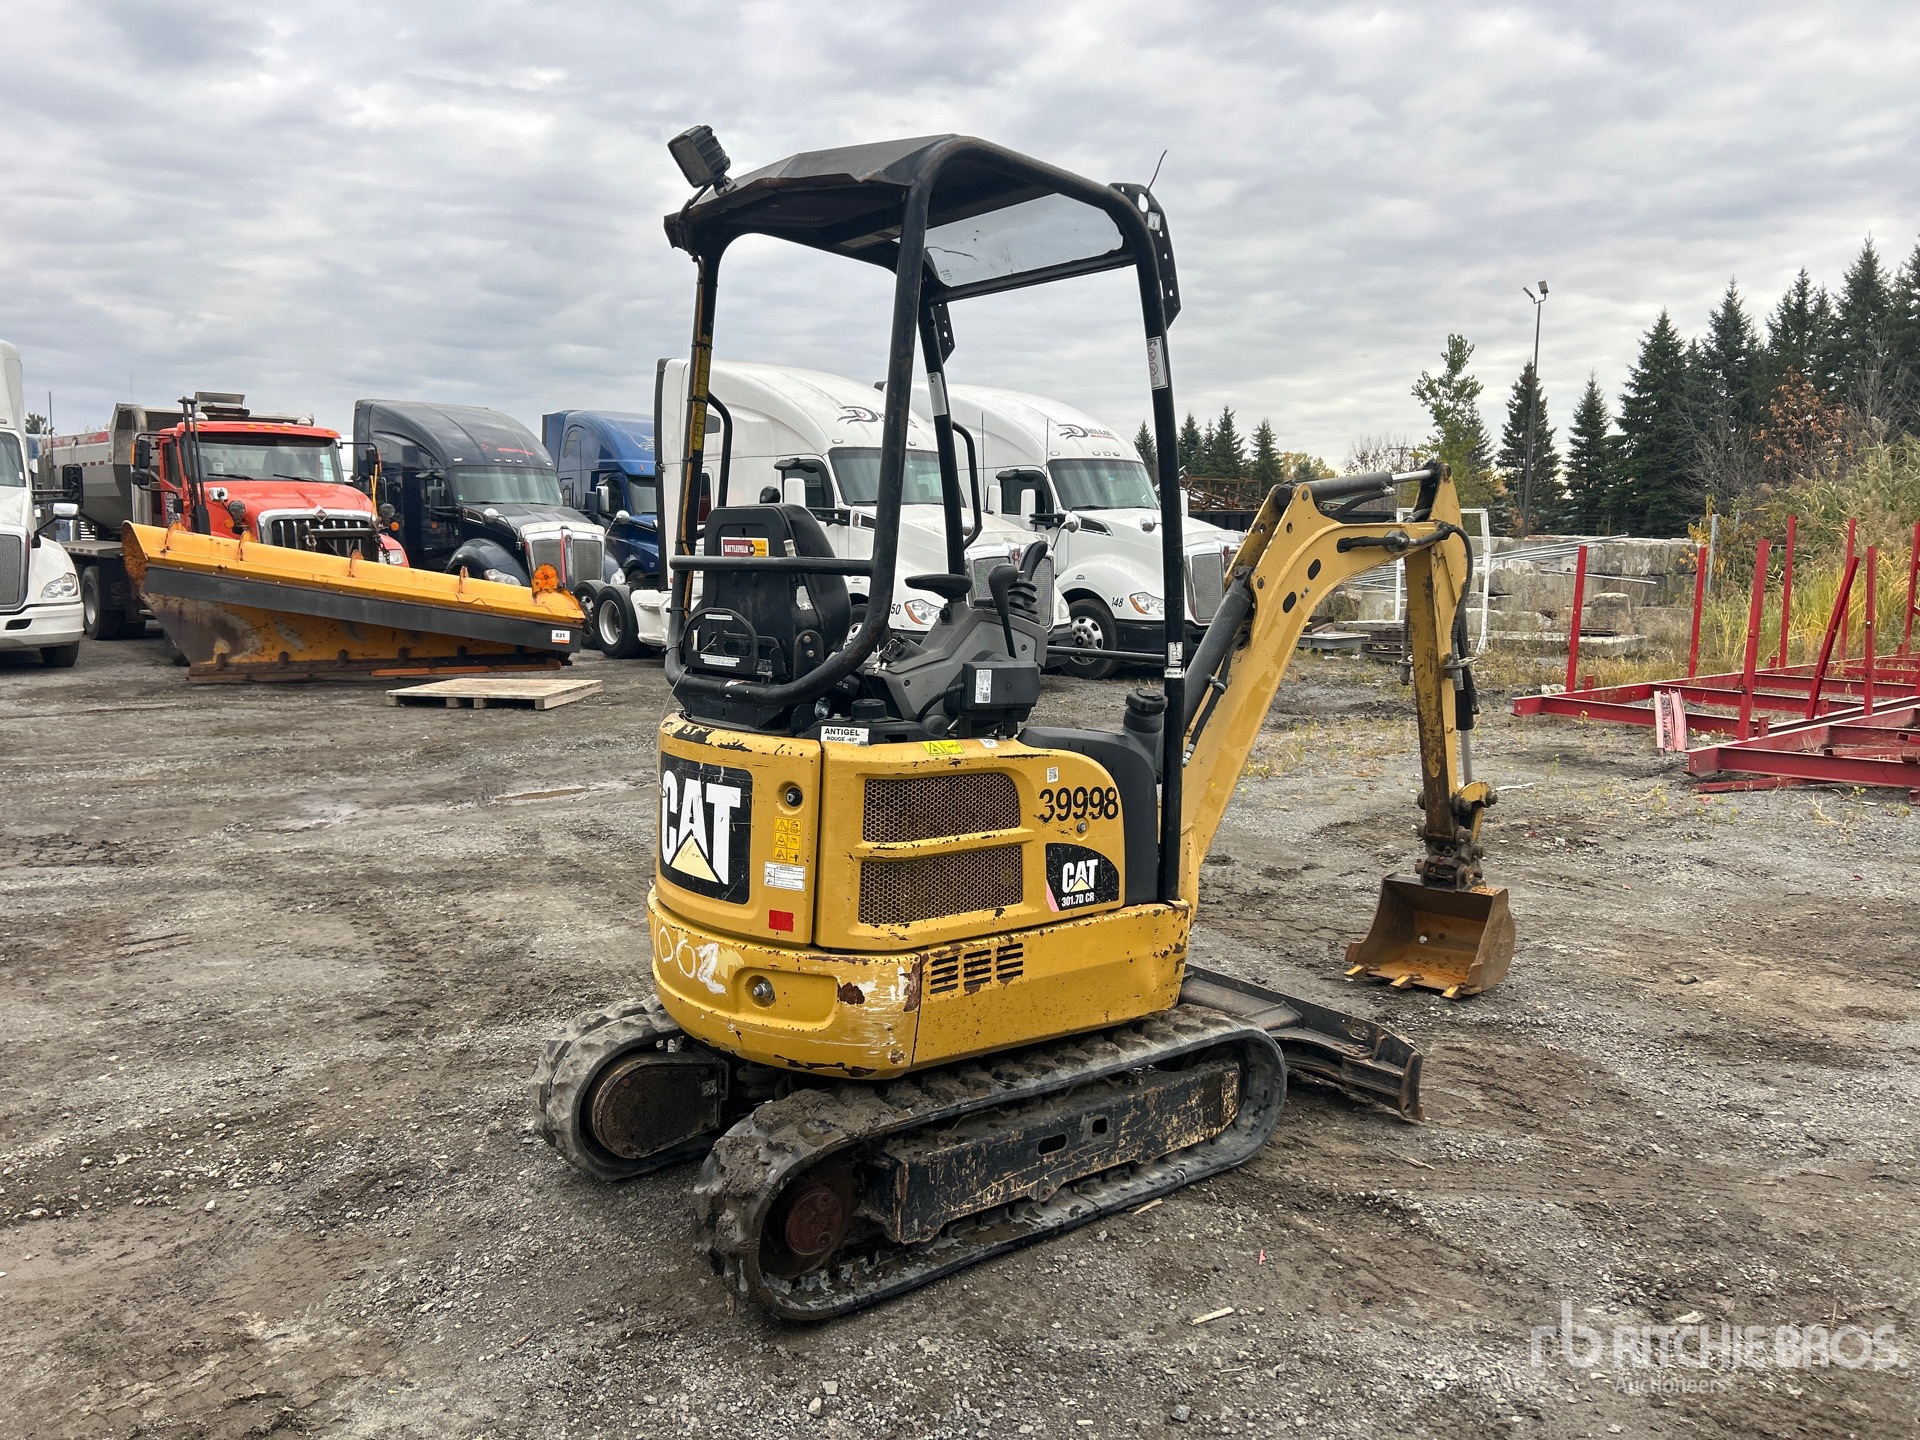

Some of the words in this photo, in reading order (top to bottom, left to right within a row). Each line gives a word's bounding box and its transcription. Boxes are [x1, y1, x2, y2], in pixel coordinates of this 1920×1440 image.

[1111, 597, 1124, 607] 148
[824, 727, 860, 737] ANTIGEL
[1038, 786, 1119, 823] 39998
[662, 769, 742, 886] CAT
[1062, 858, 1099, 894] CAT
[1061, 893, 1084, 907] 301.7D
[1085, 891, 1095, 903] CR
